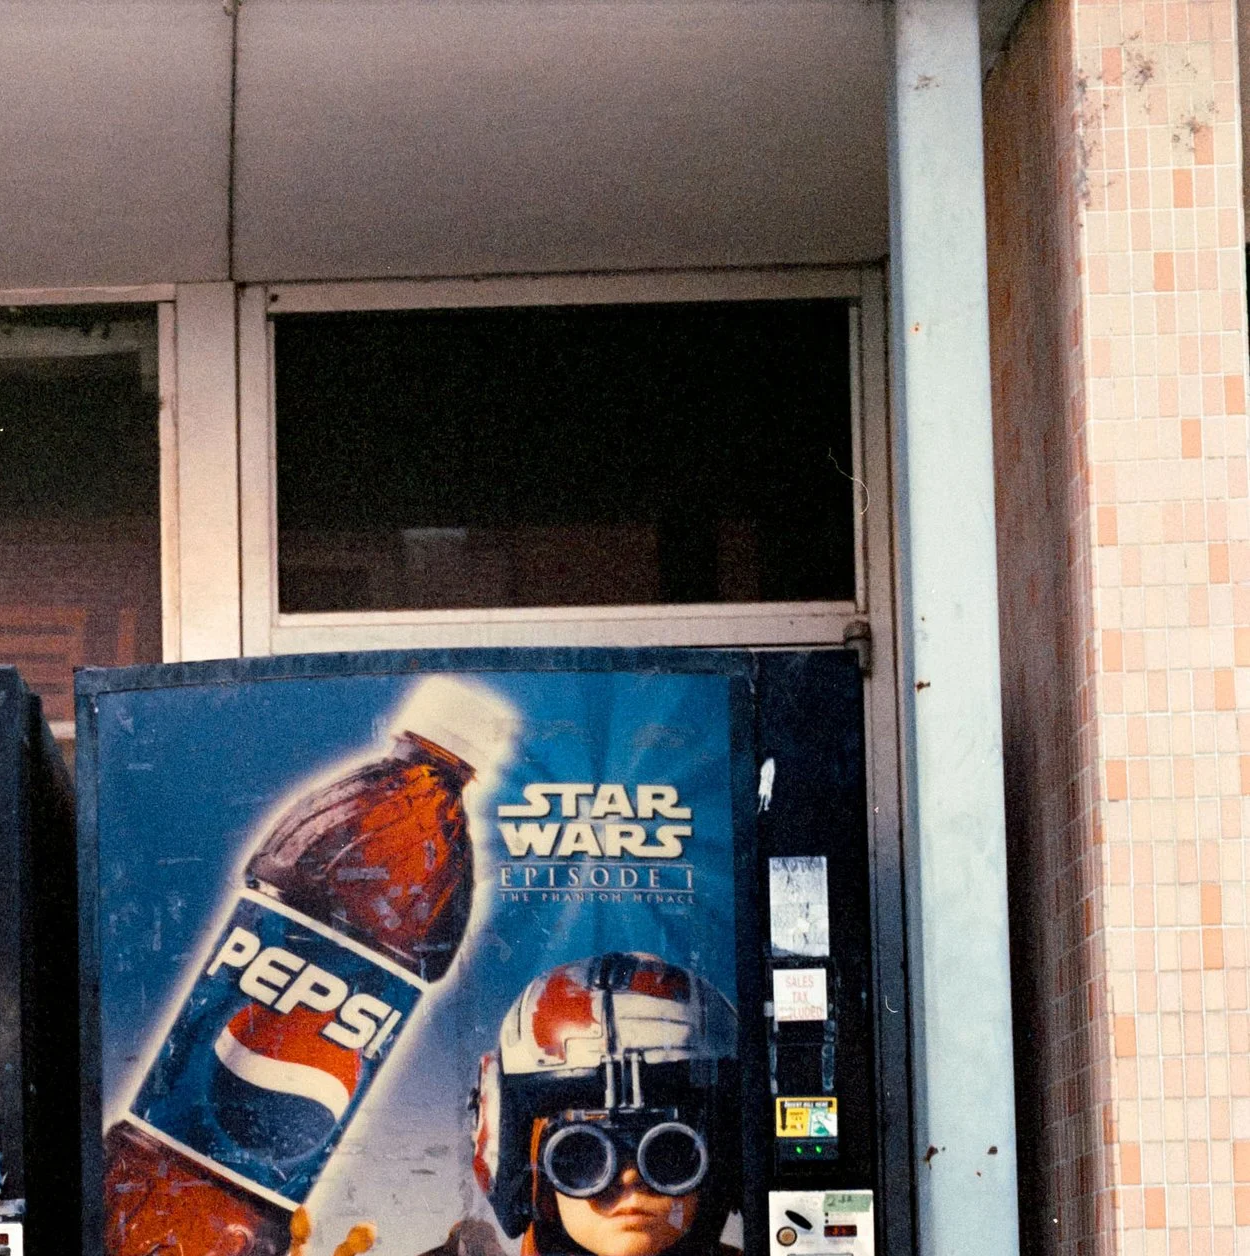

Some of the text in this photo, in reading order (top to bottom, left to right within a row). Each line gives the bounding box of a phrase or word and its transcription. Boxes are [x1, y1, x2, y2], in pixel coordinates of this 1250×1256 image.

[497, 783, 692, 820] STAR
[498, 823, 692, 859] WARS
[501, 866, 694, 889] EPISODE I
[542, 892, 622, 903] PHANTOM
[206, 926, 402, 1059] PEPSI
